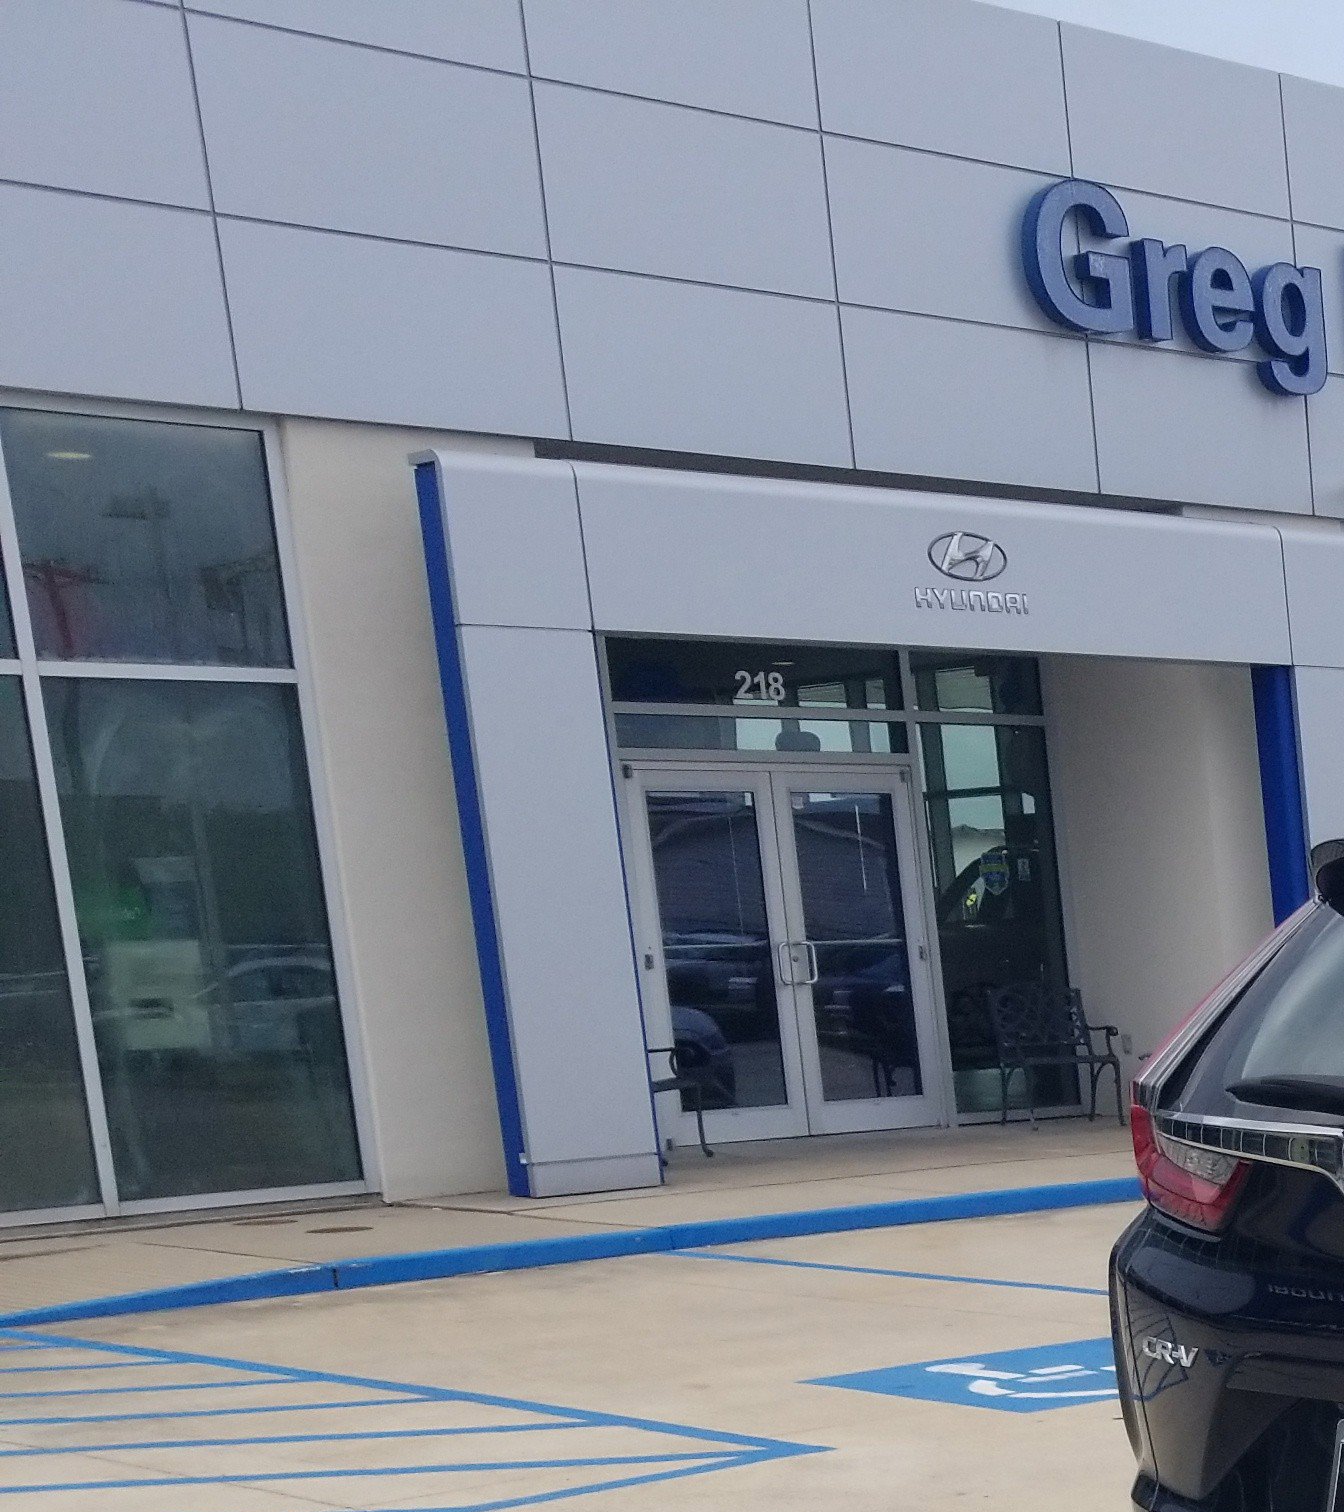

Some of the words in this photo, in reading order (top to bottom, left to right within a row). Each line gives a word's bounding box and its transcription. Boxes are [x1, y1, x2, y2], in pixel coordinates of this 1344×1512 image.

[1021, 179, 1328, 396] Greg
[914, 586, 1029, 615] HYUNDAI
[734, 670, 786, 700] 218
[1142, 1335, 1199, 1368] CR-V
